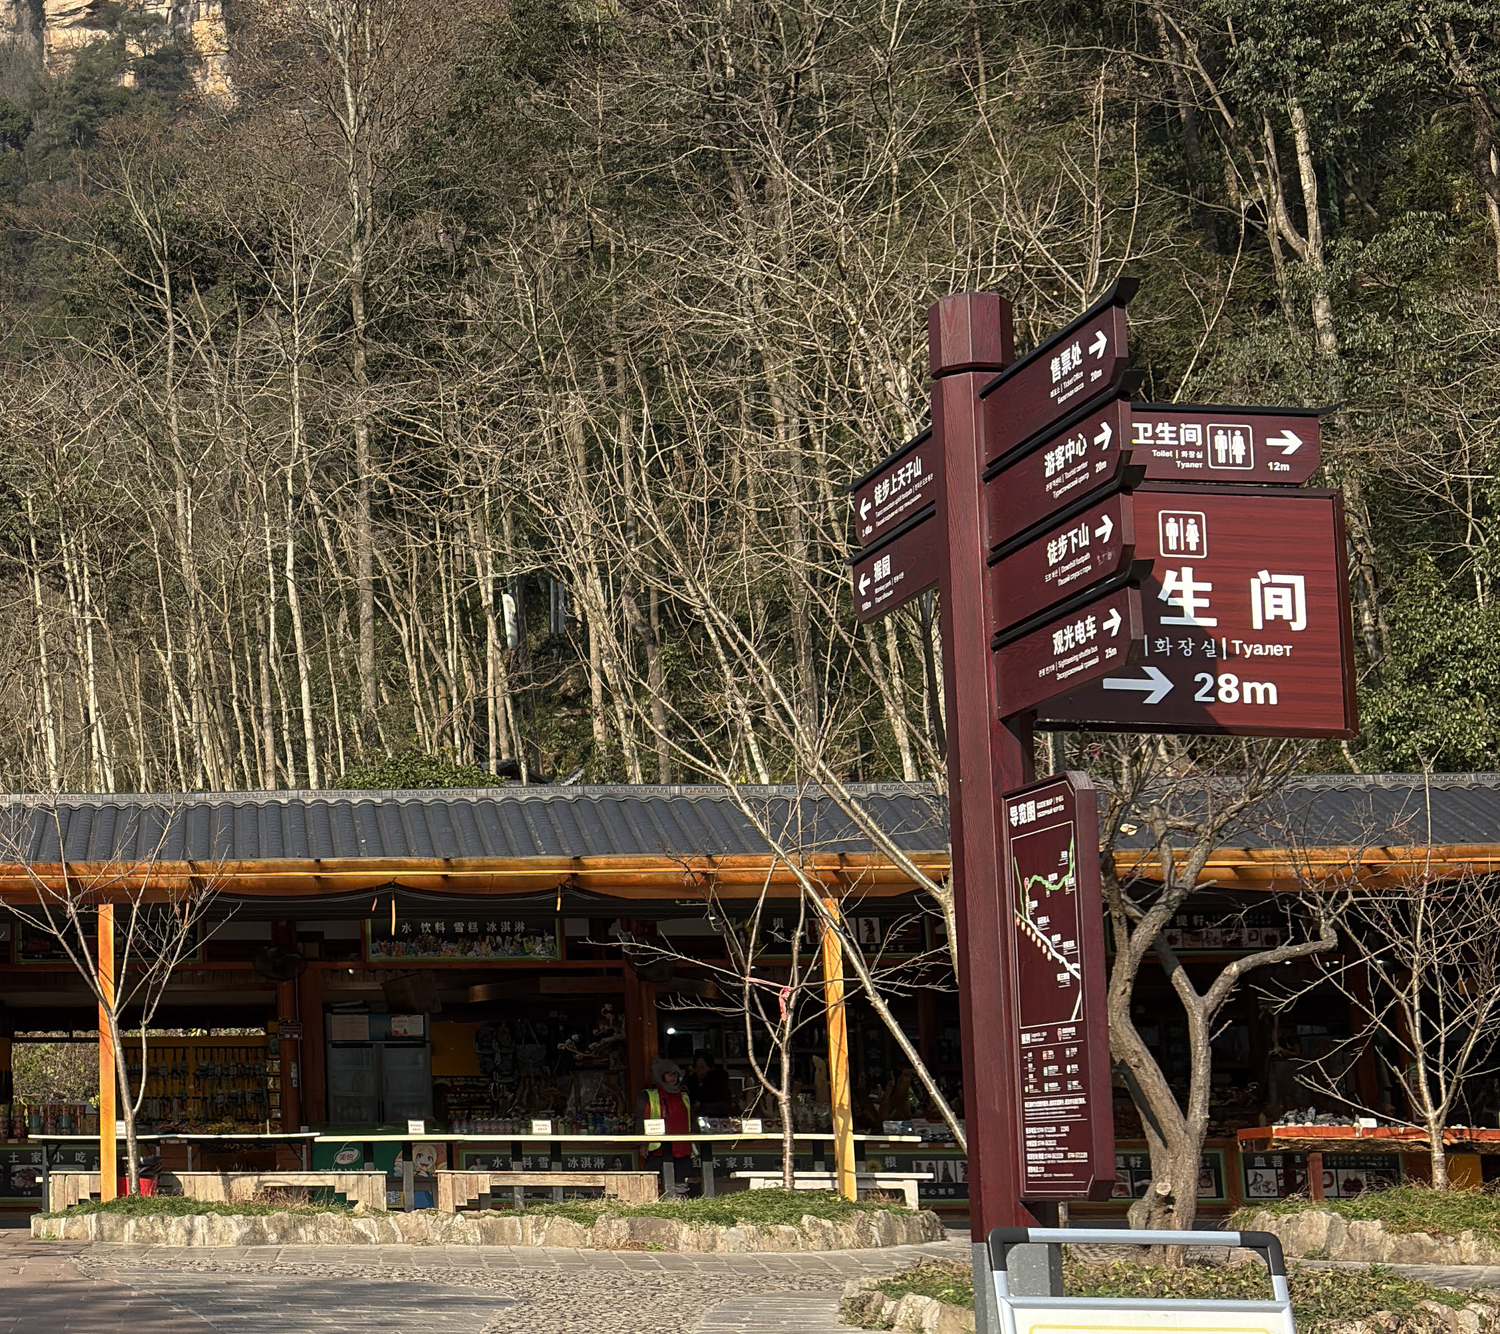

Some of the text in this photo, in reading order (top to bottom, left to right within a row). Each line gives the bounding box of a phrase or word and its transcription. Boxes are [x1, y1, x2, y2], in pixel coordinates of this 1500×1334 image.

[1050, 340, 1083, 384] 售票处
[1131, 421, 1203, 446] 卫生间
[1044, 432, 1088, 478] 游客中心
[1151, 449, 1173, 458] Toilet
[1176, 460, 1203, 470] Туалет
[1267, 461, 1290, 472] 12m
[874, 455, 922, 507] 徒步上天子山
[1046, 522, 1090, 567] 徒步下山
[873, 554, 891, 584] 猴园
[1052, 614, 1098, 656] 观光电车
[1153, 636, 1217, 658] 화장실
[1230, 639, 1293, 659] Туалет
[1193, 672, 1278, 706] 28m
[1009, 799, 1037, 828] 导览图
[401, 921, 526, 934] 水 饮料 雪糕 冰淇淋
[492, 1156, 504, 1169] 水
[567, 1156, 606, 1169] 冰淇淋
